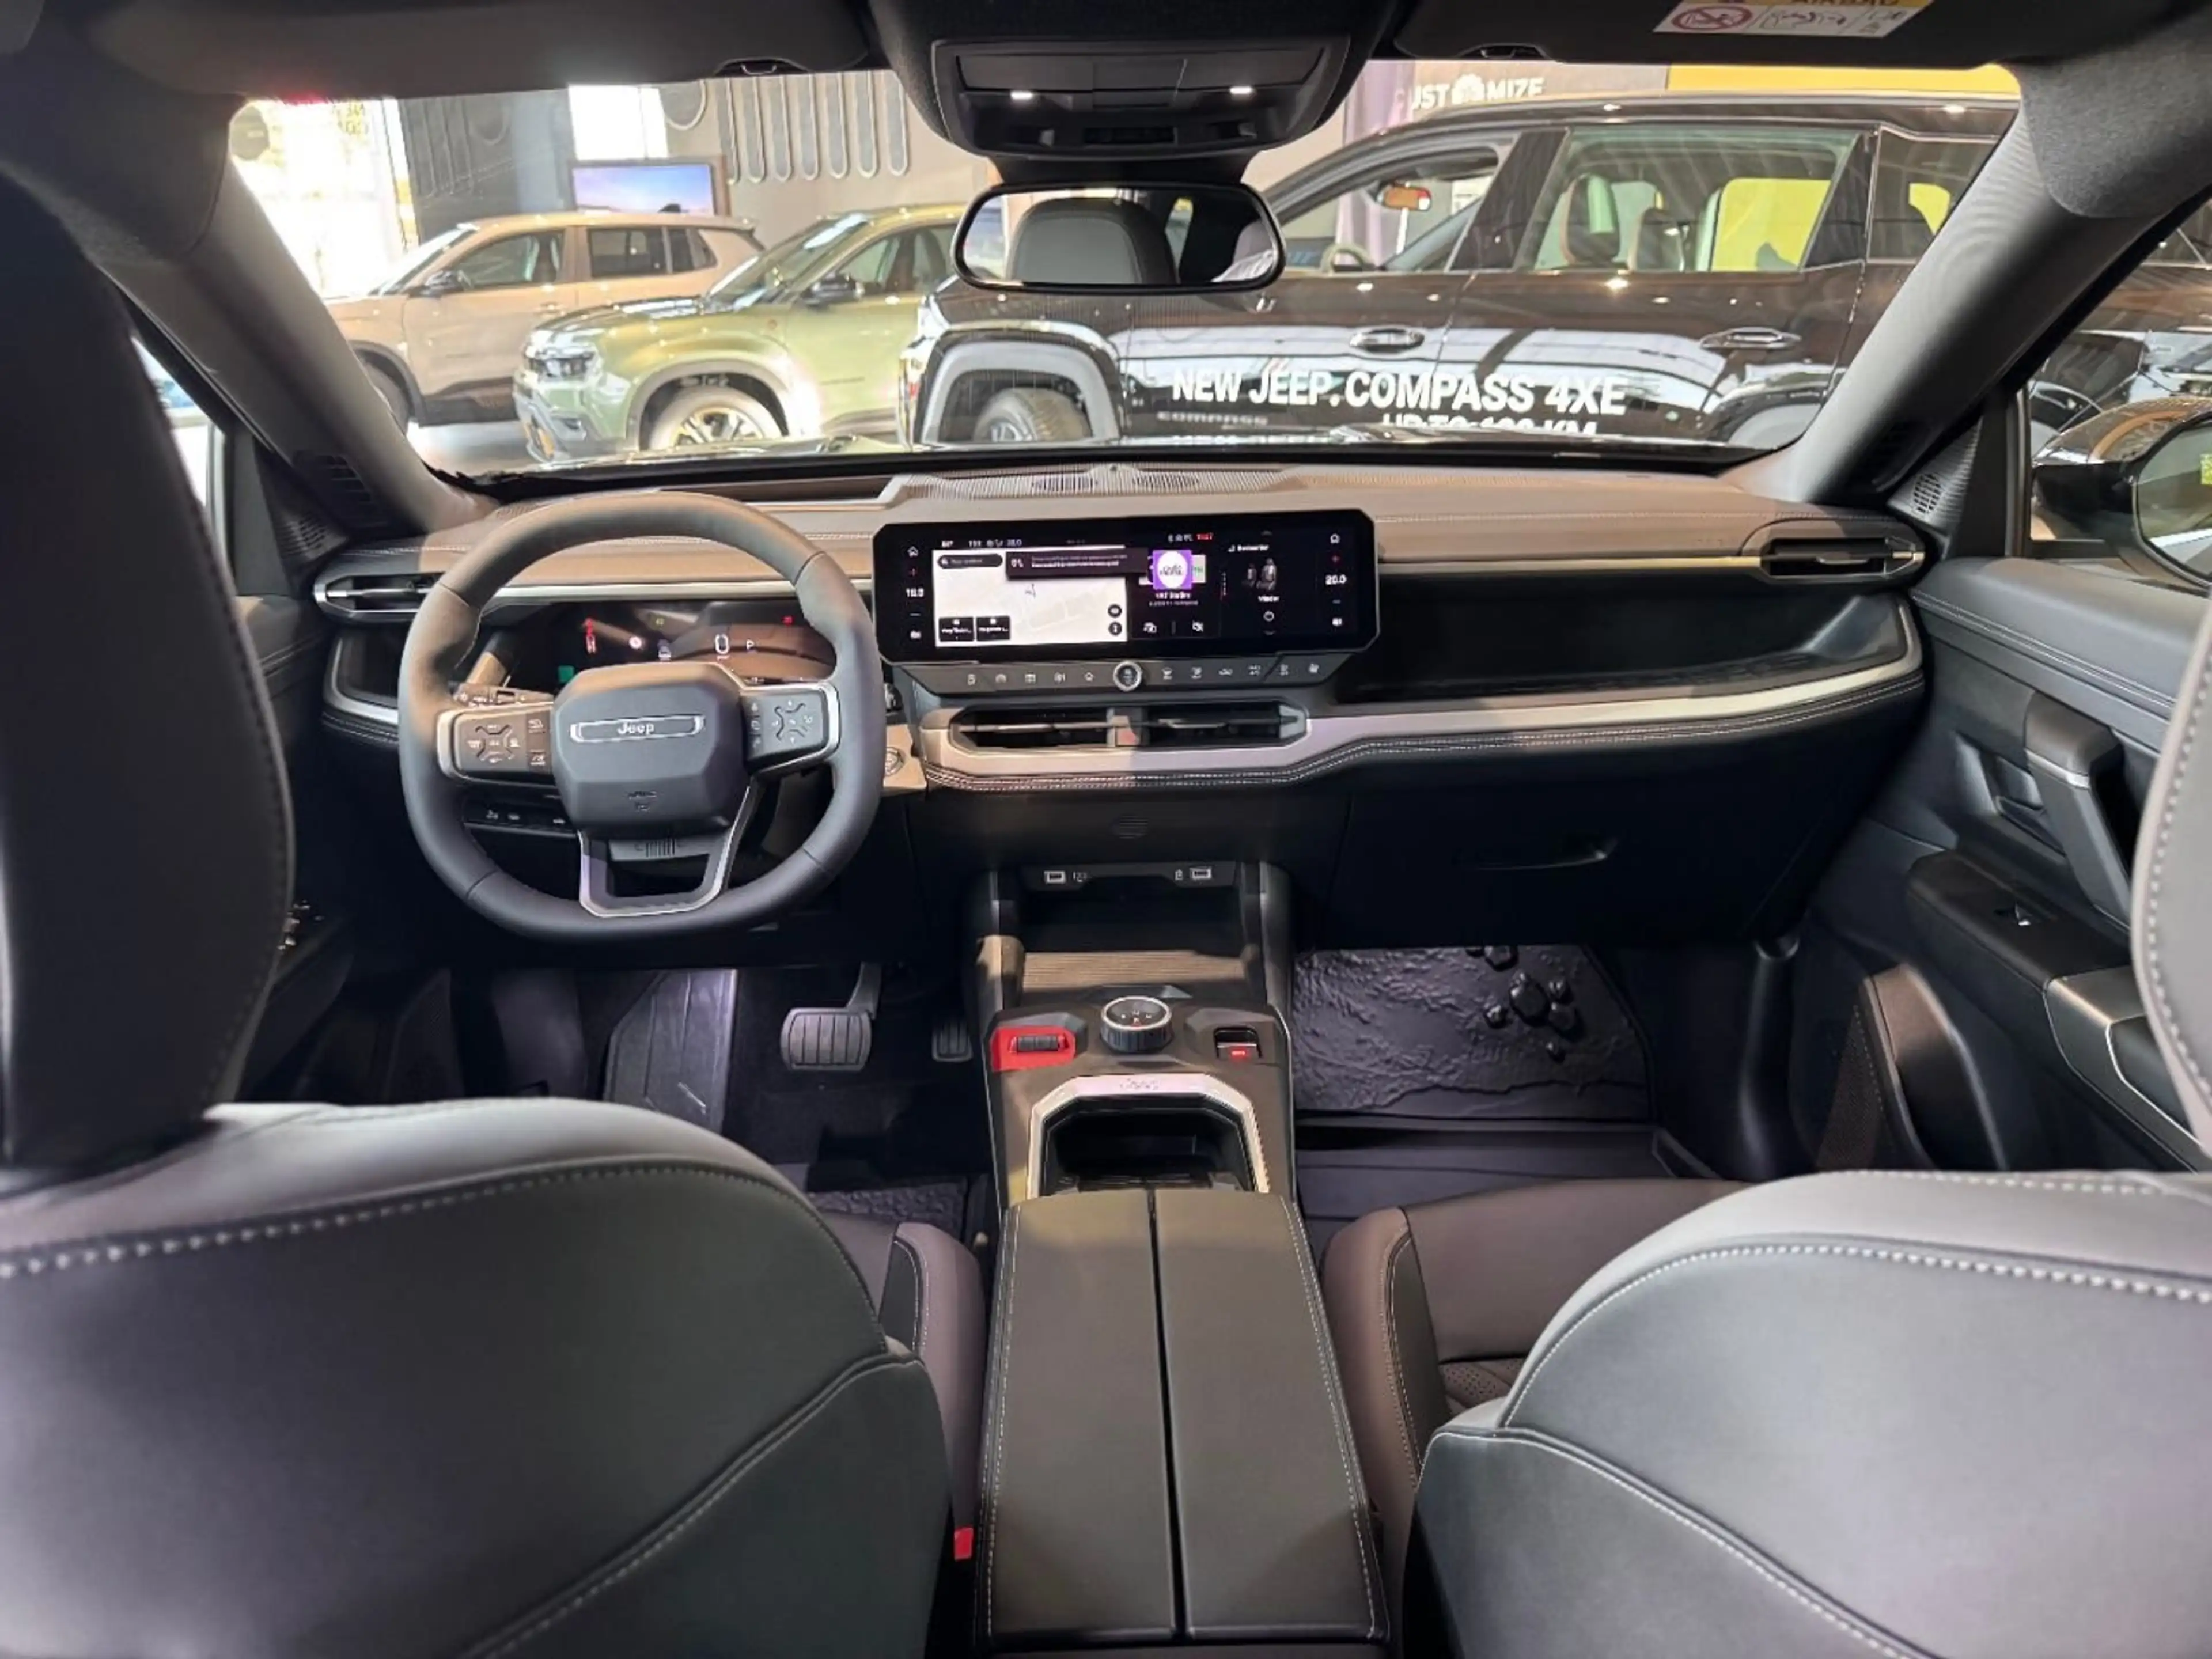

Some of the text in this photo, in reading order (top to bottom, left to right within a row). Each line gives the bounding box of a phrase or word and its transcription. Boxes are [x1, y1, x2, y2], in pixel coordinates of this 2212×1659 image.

[1172, 370, 1242, 402] NEW
[1344, 372, 1535, 413] COMPASS
[1544, 375, 1627, 415] 4XE
[616, 722, 655, 736] Jeep
